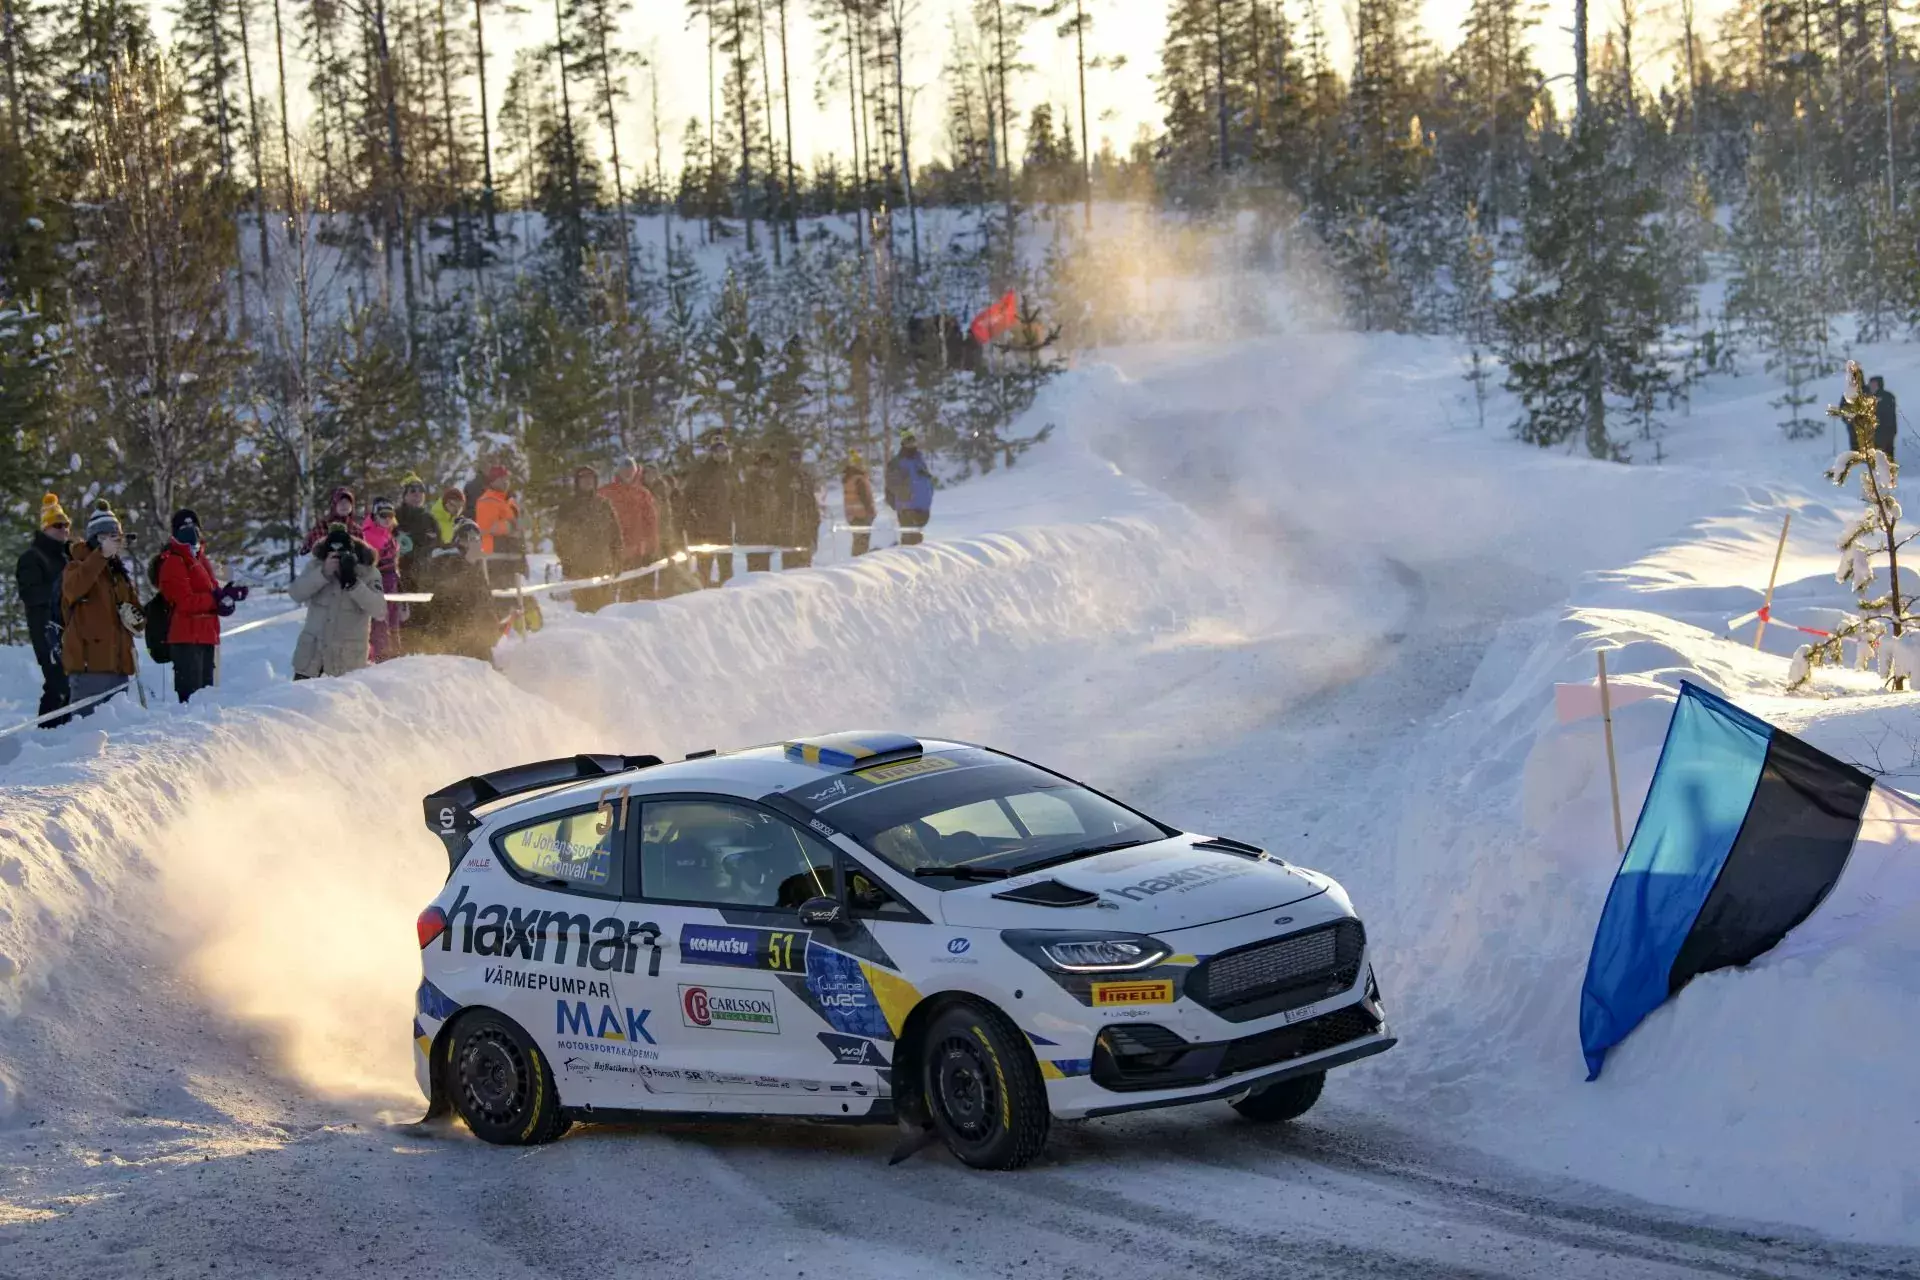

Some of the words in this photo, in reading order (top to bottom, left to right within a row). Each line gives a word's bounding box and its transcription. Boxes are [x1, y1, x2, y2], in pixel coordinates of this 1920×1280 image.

[596, 784, 632, 836] 51
[534, 833, 593, 857] Johansson
[467, 858, 491, 867] MILLE
[442, 886, 662, 977] haxman
[690, 937, 749, 955] KOMATSU
[768, 932, 795, 970] 51
[484, 965, 610, 999] VÄRMEPUMPAR
[1098, 984, 1167, 1002] PIRELLI
[709, 997, 772, 1014] CARLSSON
[820, 993, 868, 1007] WRC
[557, 999, 658, 1046] MAK
[558, 1040, 659, 1061] MOTORSPORTAKADEMIN
